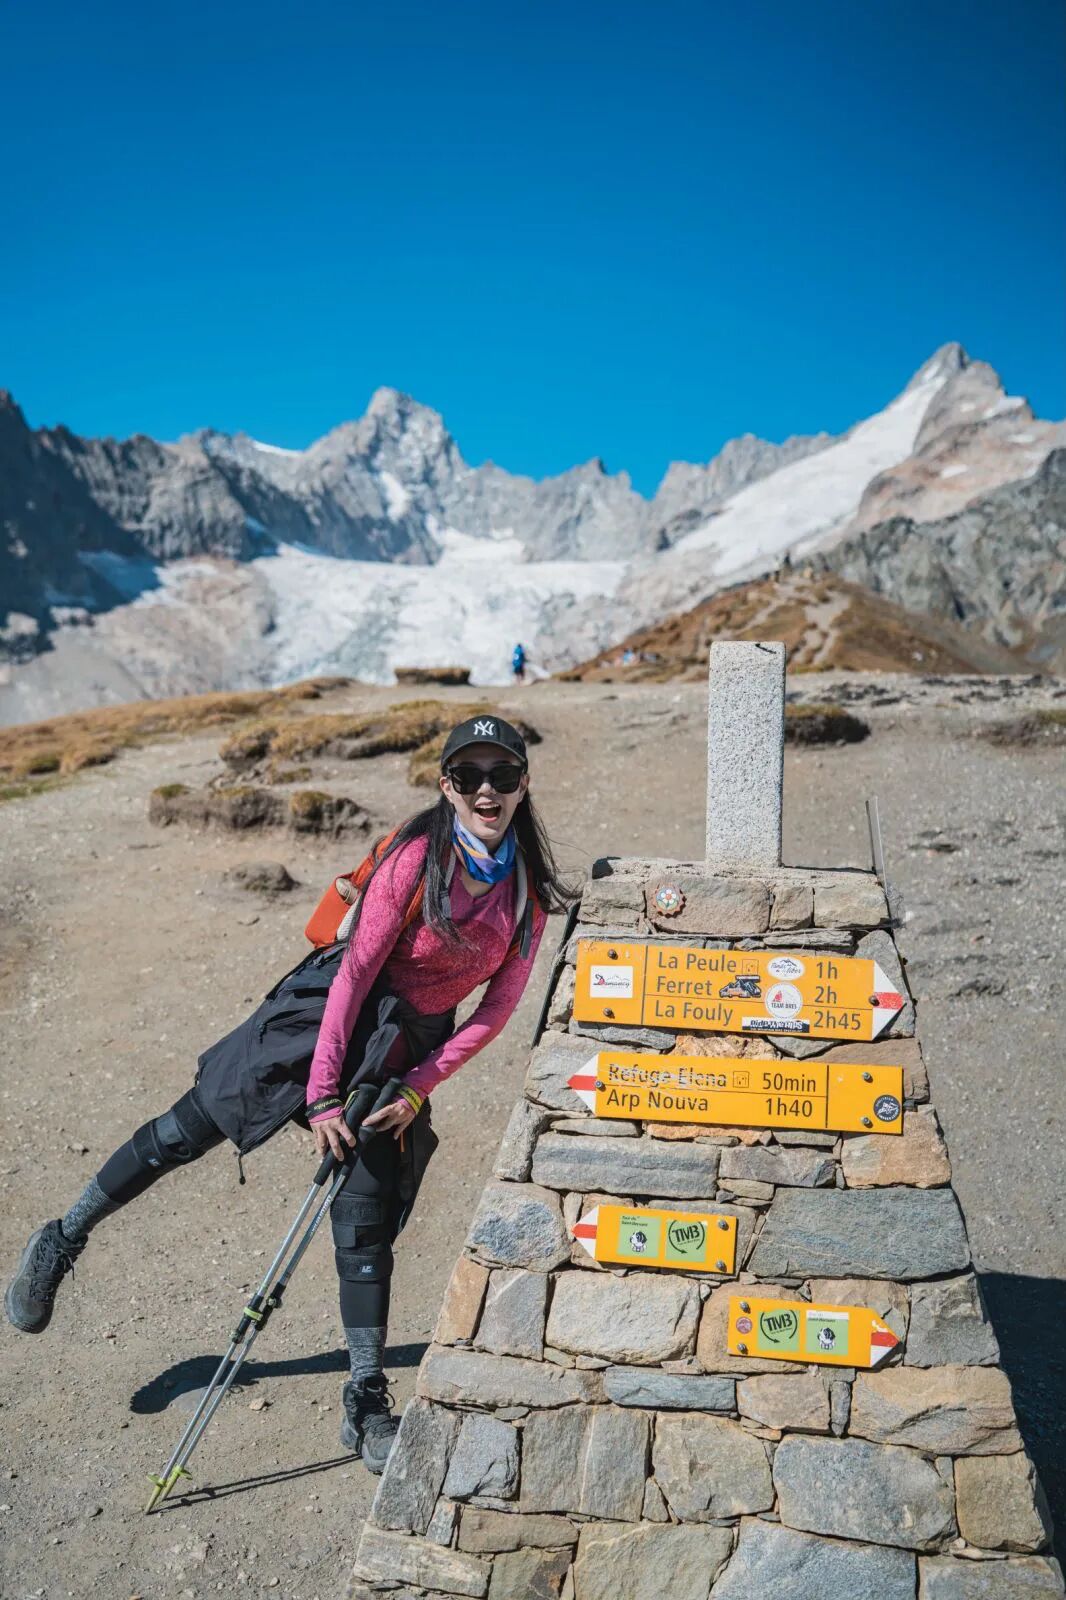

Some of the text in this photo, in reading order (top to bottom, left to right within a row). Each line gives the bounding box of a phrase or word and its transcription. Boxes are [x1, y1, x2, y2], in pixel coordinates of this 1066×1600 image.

[473, 720, 495, 736] NY
[658, 951, 737, 973] La Peule
[816, 961, 838, 979] 1h
[656, 975, 712, 996] Ferret
[814, 986, 837, 1004] 2h
[655, 1000, 733, 1026] La Fouly
[813, 1010, 861, 1030] 2h45
[608, 1063, 727, 1087] Refuge Elena
[762, 1072, 816, 1092] 50min
[606, 1089, 708, 1112] Arp Nouva
[766, 1097, 813, 1118] 1h40
[671, 1224, 700, 1242] TMB
[763, 1313, 793, 1331] TMB
